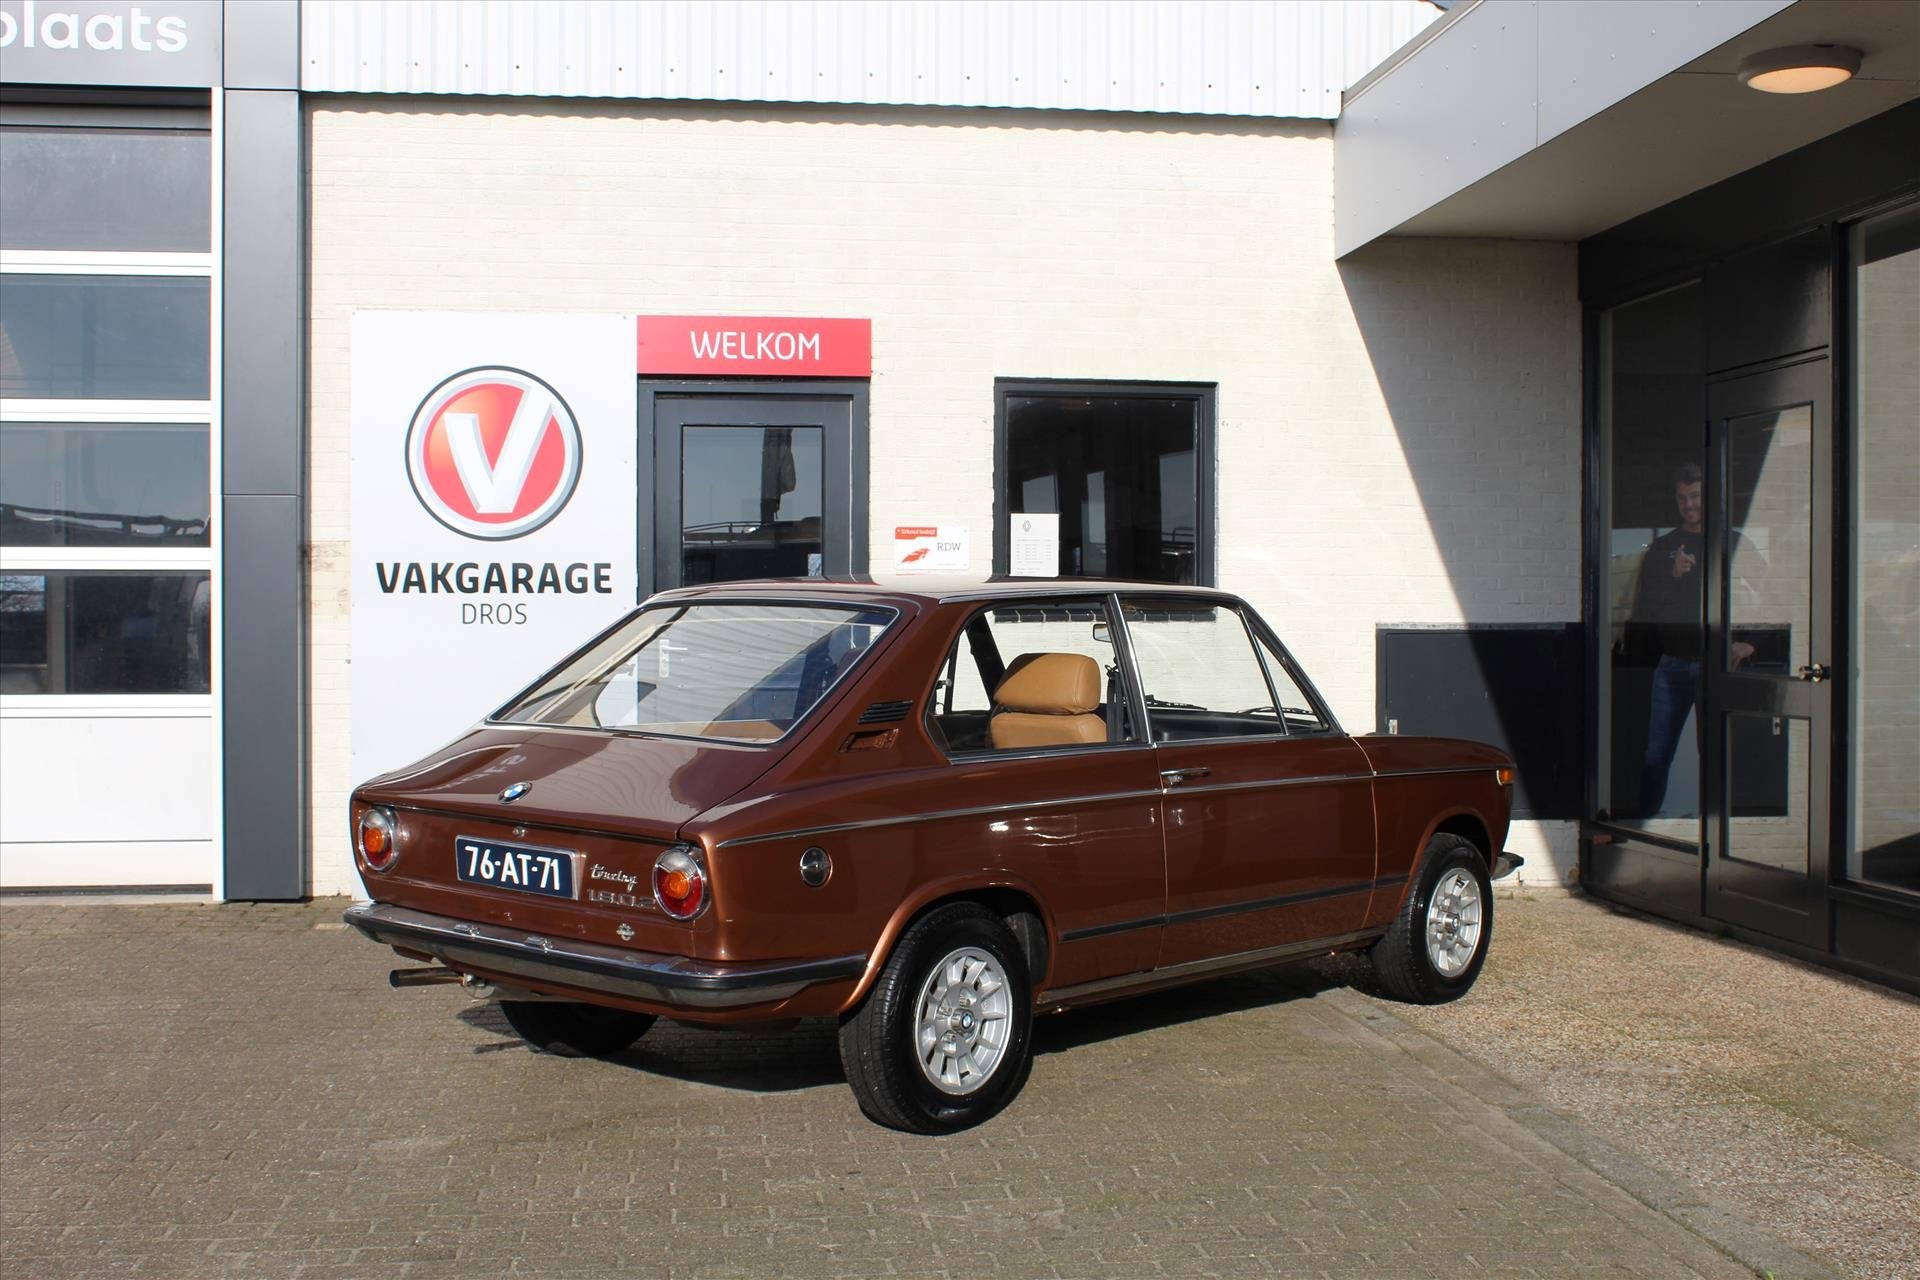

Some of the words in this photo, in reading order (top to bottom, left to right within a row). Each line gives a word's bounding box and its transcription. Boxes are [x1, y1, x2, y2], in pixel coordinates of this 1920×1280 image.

[690, 331, 820, 360] WELKOM
[937, 542, 961, 551] RDW
[376, 562, 612, 594] VAKGARAGE
[461, 603, 527, 625] DROS
[465, 845, 560, 891] 76-AT-71
